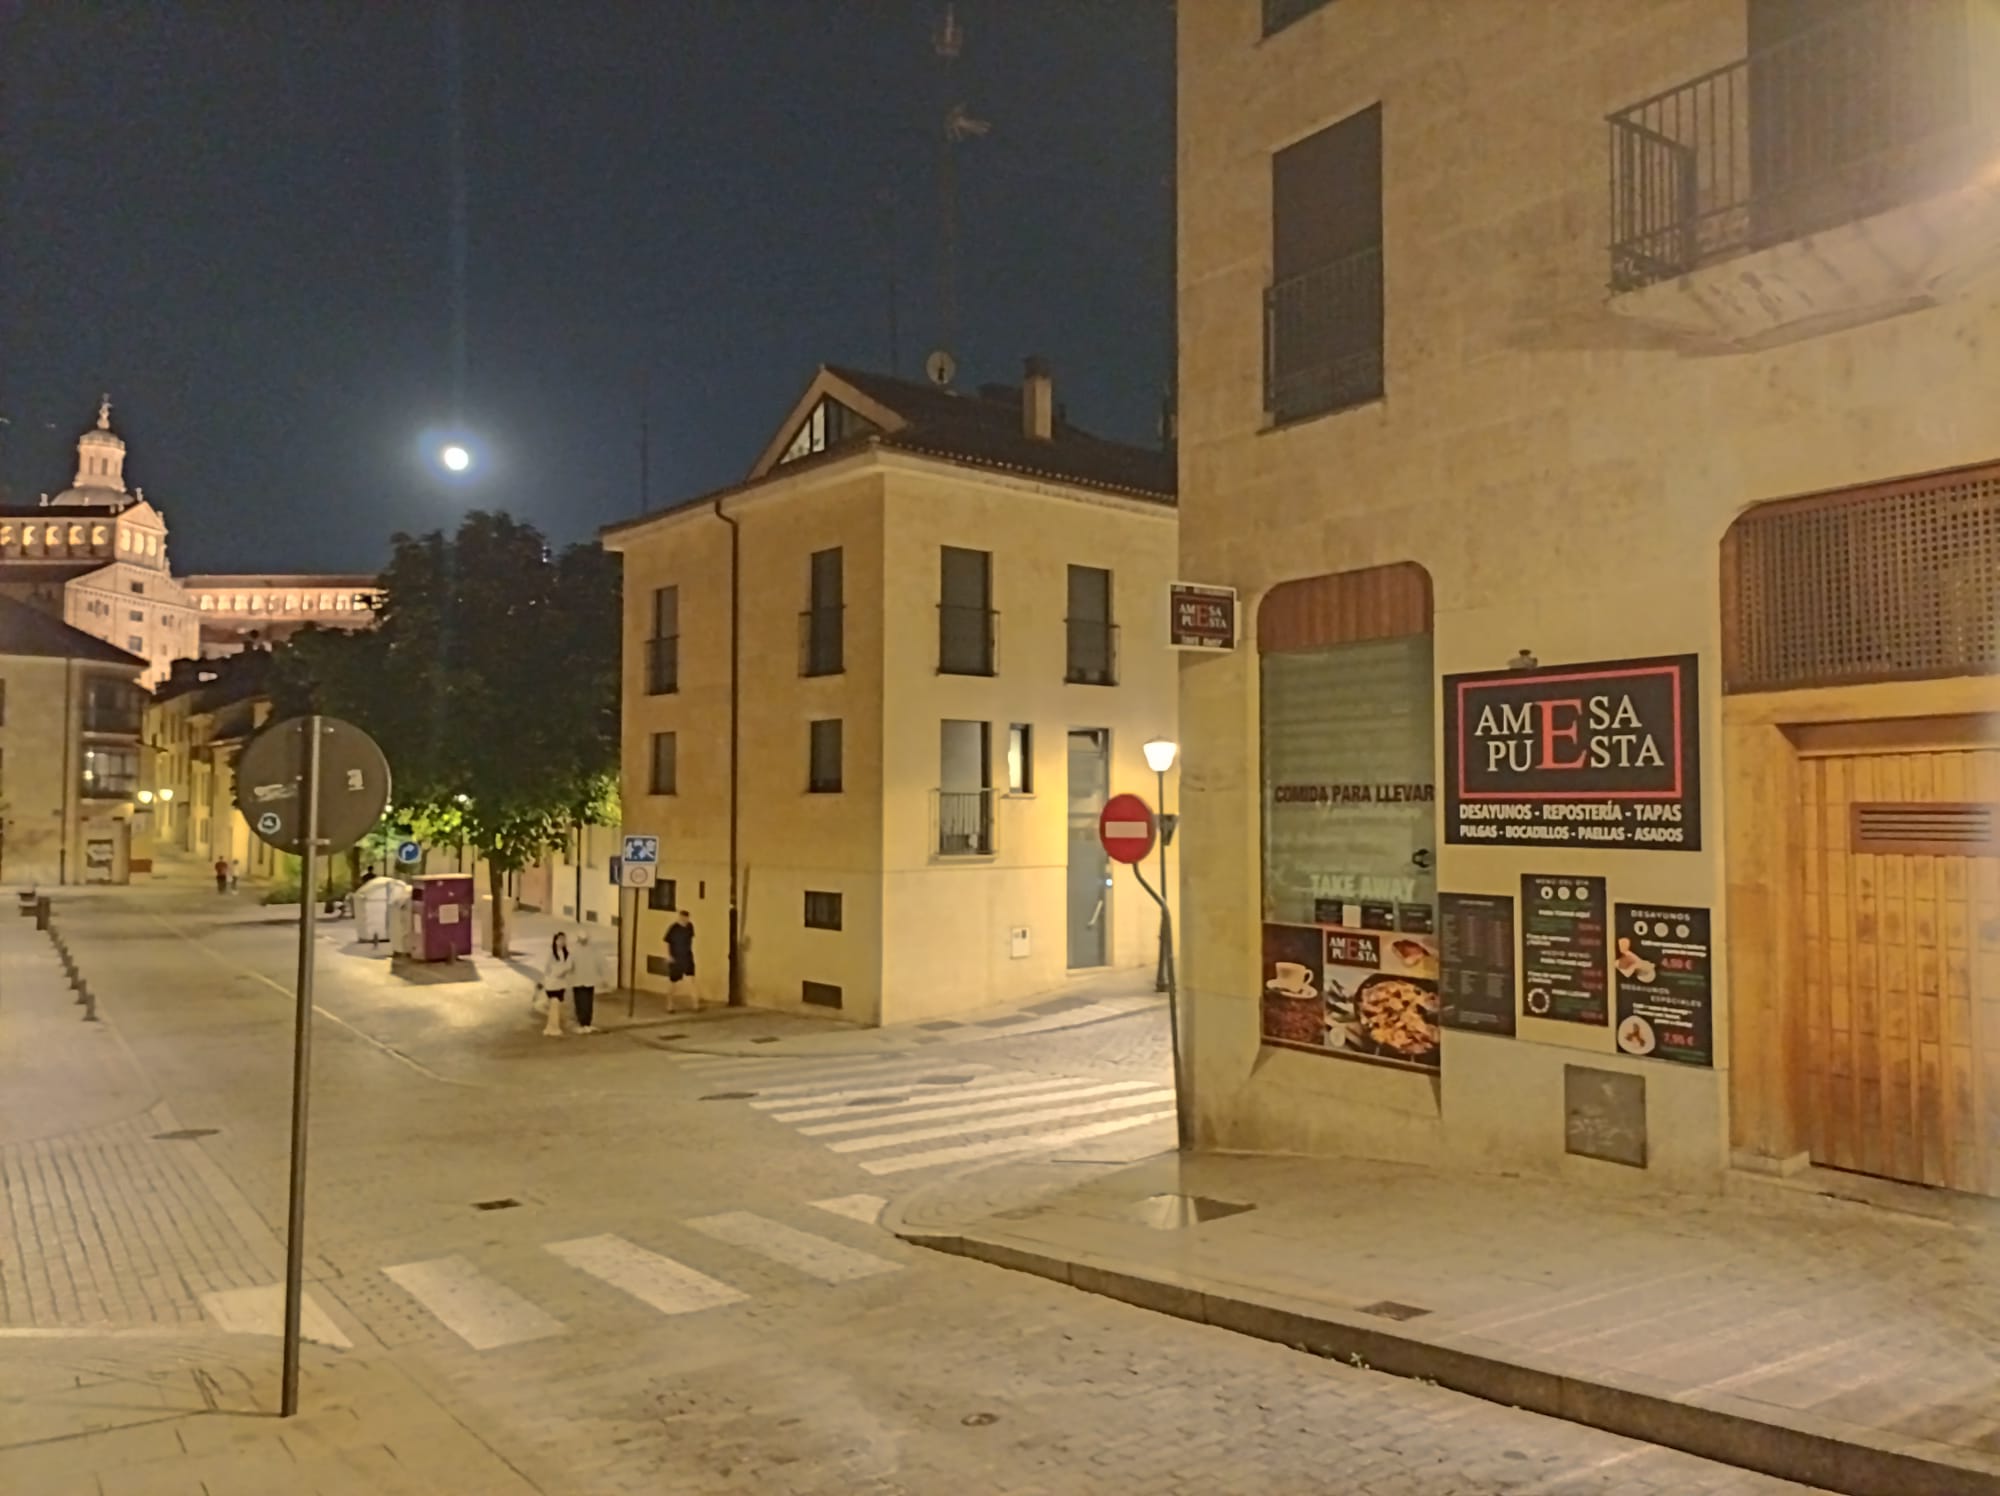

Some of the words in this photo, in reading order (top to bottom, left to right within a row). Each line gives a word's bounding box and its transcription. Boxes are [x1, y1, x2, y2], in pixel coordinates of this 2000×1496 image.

[1275, 784, 1328, 803] COMIDA
[1332, 785, 1372, 802] PARA
[1376, 784, 1435, 802] LLEVAR
[1459, 804, 1532, 820] DESAYUNOS
[1543, 801, 1622, 821] REPOSTERÍA
[1634, 804, 1682, 821] TAPAS
[1460, 825, 1497, 838] PULGAS
[1505, 825, 1569, 840] BOCADILLOS
[1578, 827, 1625, 841] PAELLAS
[1634, 827, 1683, 842] ASADOS
[1310, 874, 1356, 898] TAKE
[1631, 909, 1691, 922] DESAYUNOS
